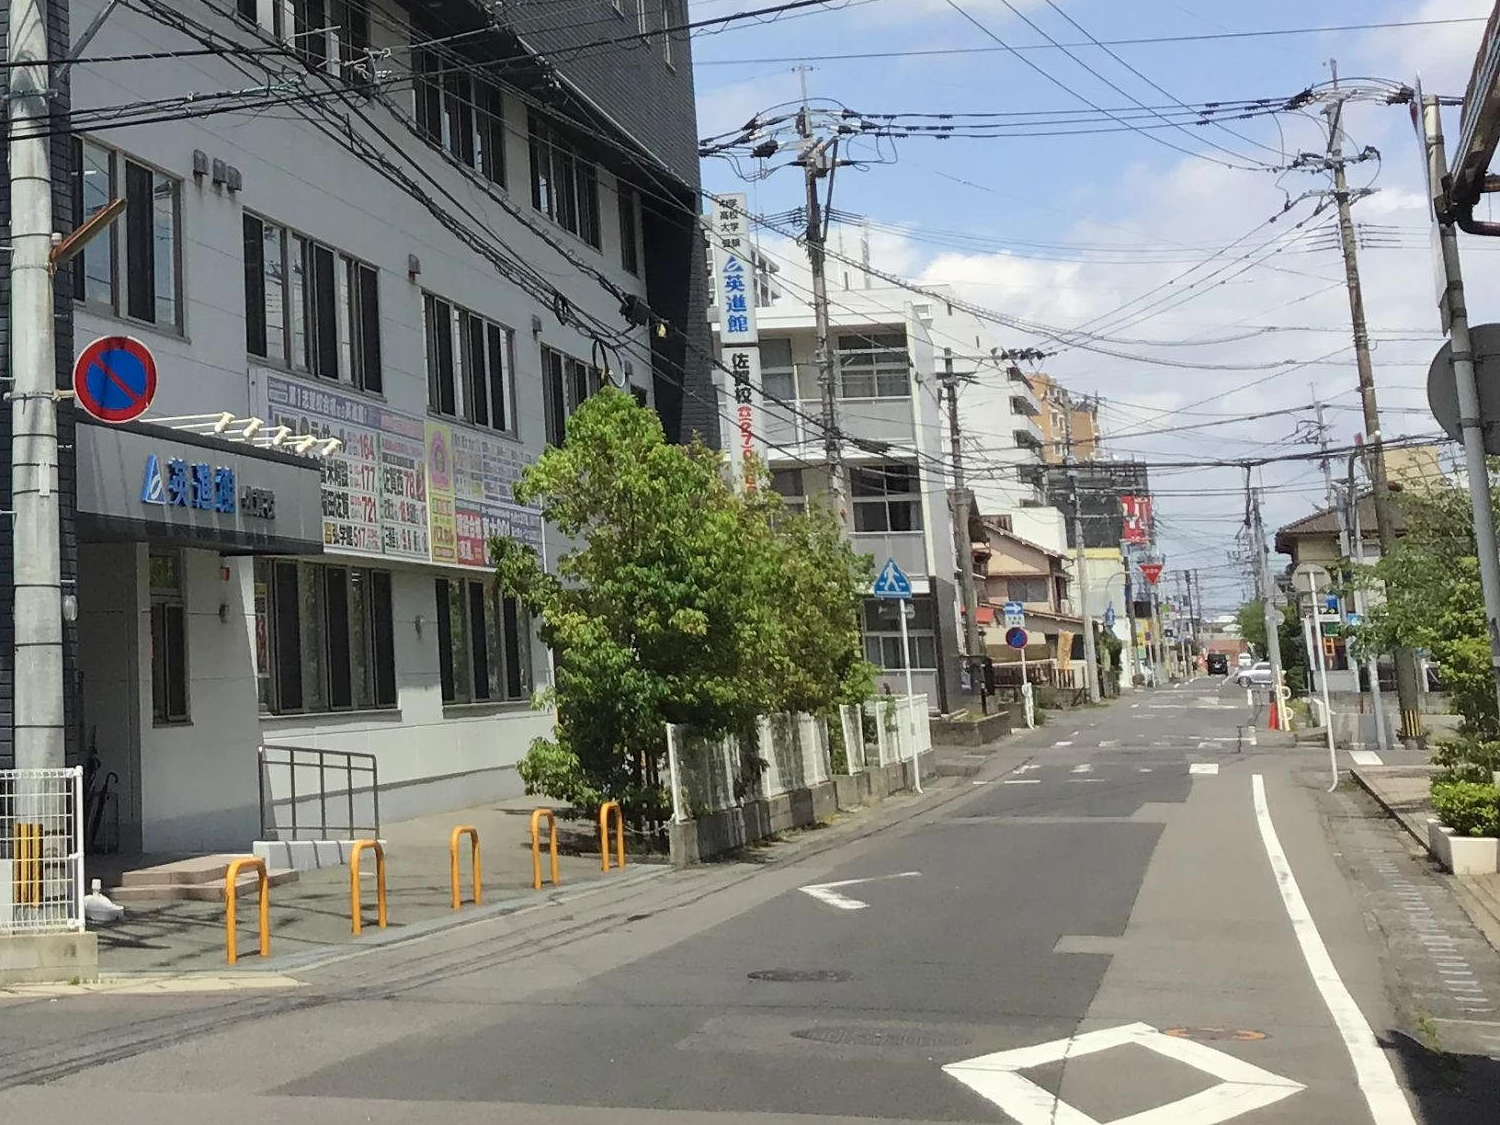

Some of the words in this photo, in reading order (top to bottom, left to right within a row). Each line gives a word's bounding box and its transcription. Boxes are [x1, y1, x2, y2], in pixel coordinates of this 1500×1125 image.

[721, 222, 740, 232] 大学
[724, 274, 749, 333] 英進館
[732, 352, 752, 404] 佐賀校
[167, 457, 237, 513] 英進館
